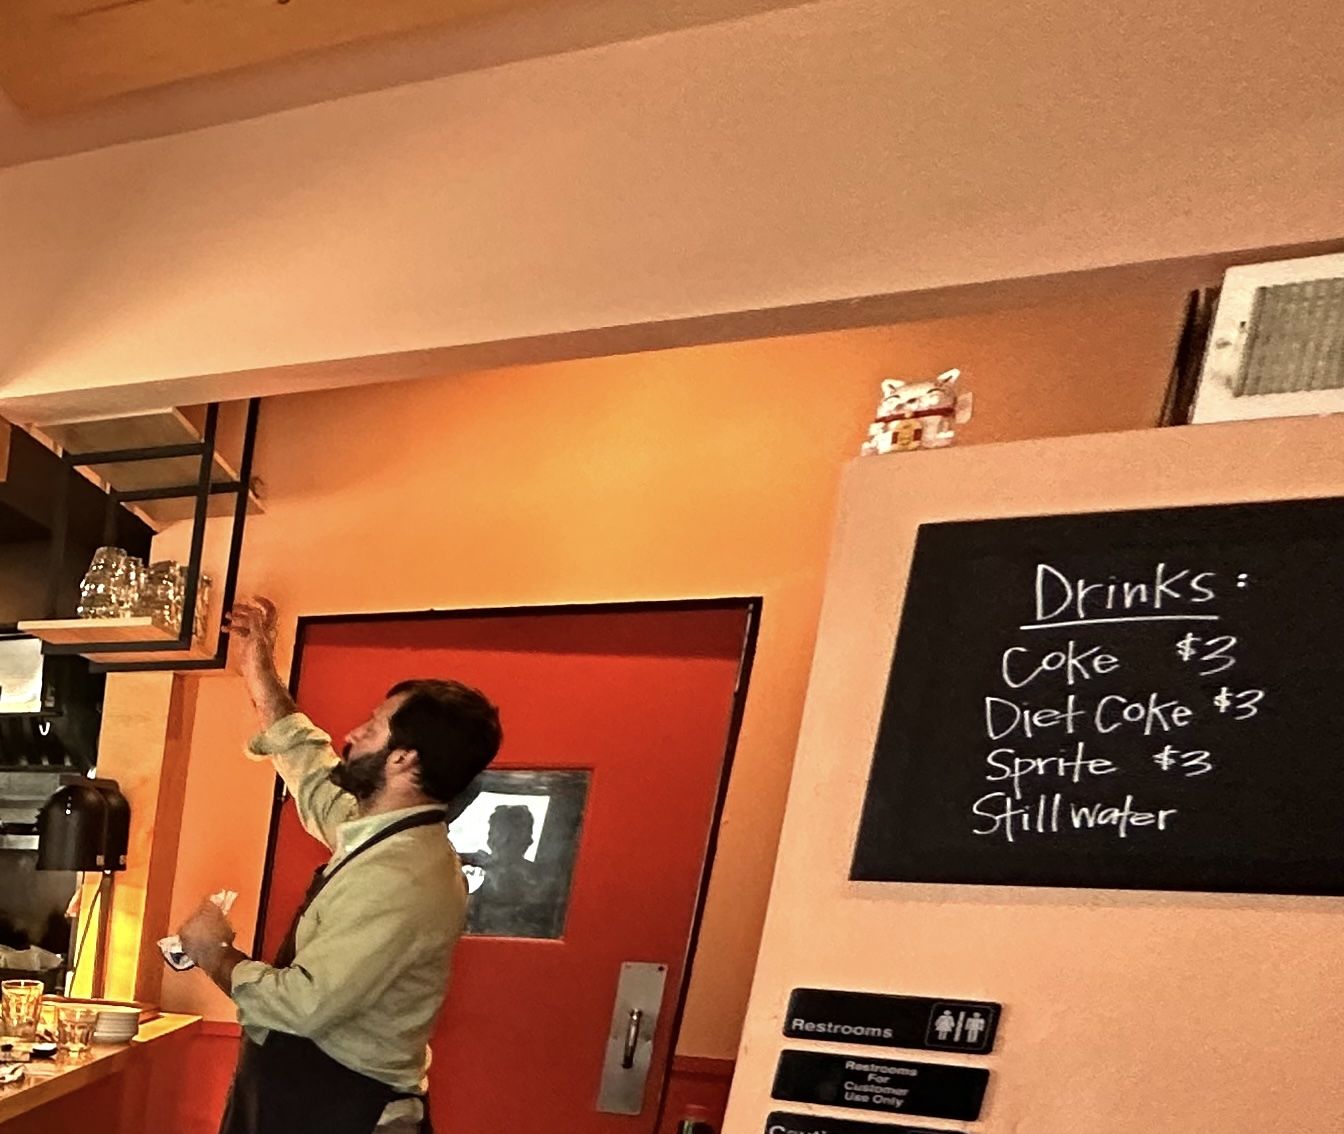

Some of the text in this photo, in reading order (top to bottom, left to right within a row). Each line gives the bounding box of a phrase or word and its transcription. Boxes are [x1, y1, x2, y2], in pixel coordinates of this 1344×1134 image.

[1002, 632, 1238, 689] Coke $3
[984, 686, 1266, 741] Diet Coke $3
[985, 741, 1214, 801] Sprite $3
[972, 791, 1062, 843] Still
[791, 1017, 894, 1039] Restrooms
[844, 1060, 918, 1077] Restrooms
[867, 1073, 892, 1084] For
[844, 1081, 910, 1097] Customer
[844, 1091, 905, 1108] Use Only
